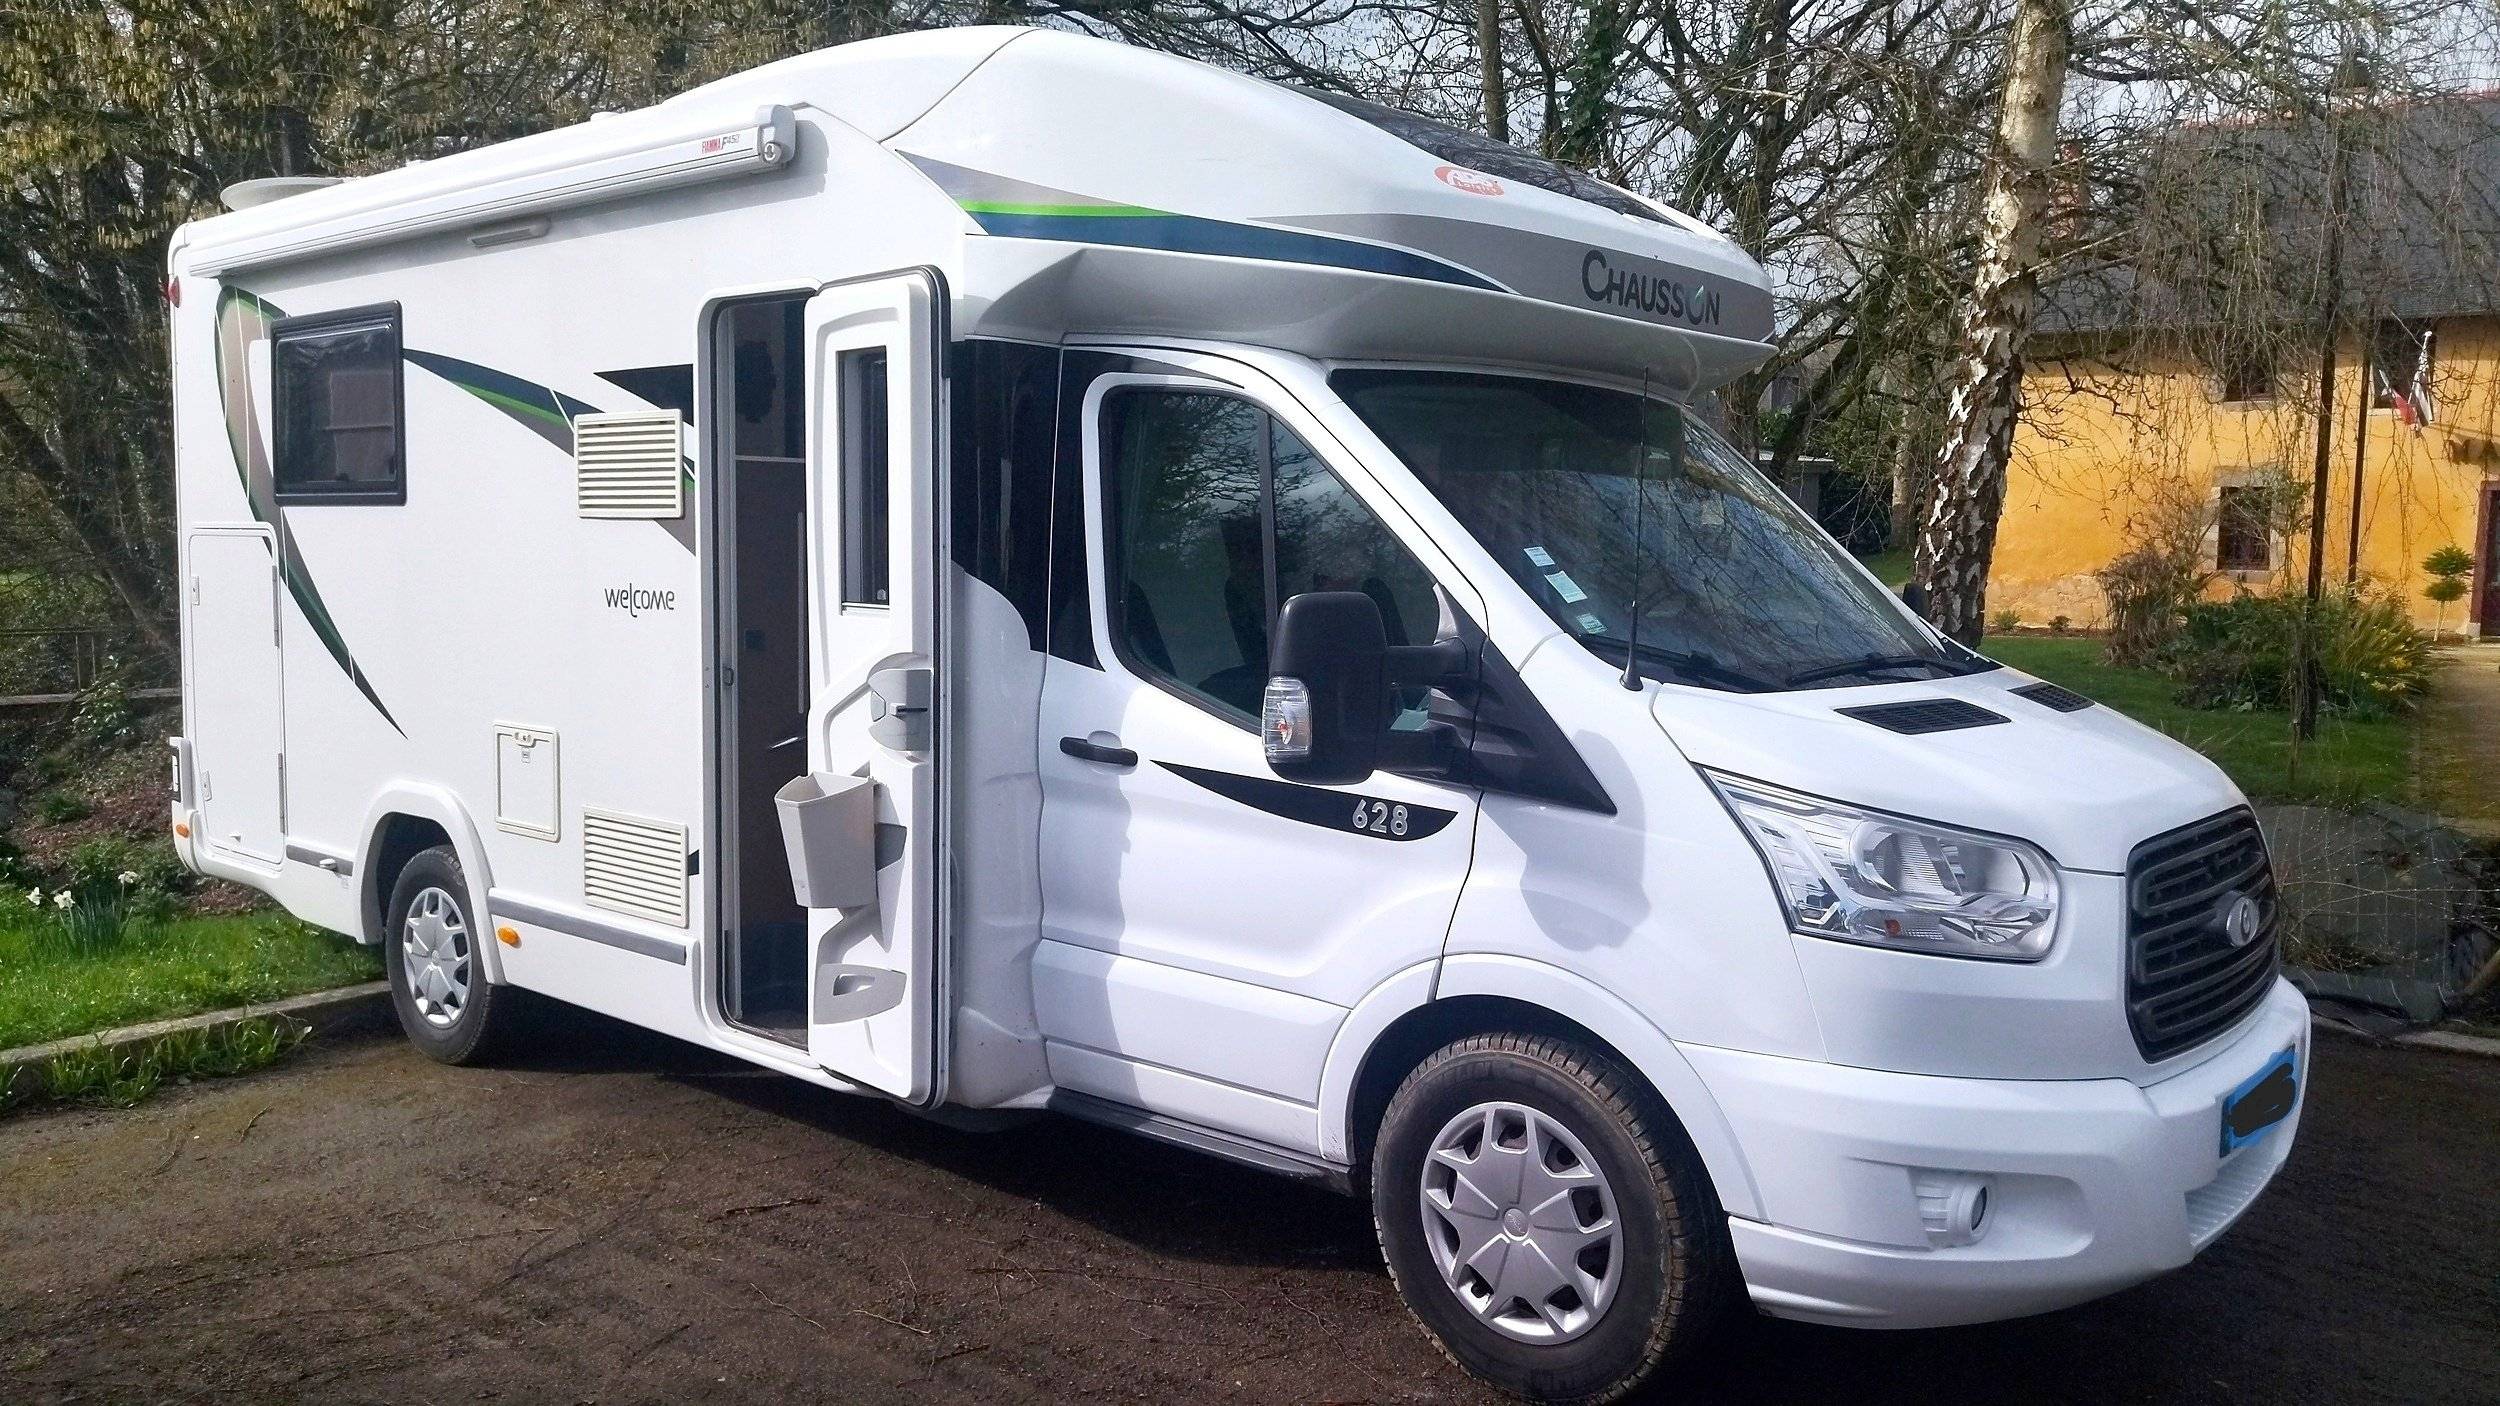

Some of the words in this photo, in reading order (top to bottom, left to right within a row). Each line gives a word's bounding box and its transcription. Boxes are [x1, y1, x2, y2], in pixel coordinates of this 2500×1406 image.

[1581, 250, 1721, 326] CHAUSSON
[604, 582, 675, 618] welcome
[1352, 798, 1408, 836] 628
